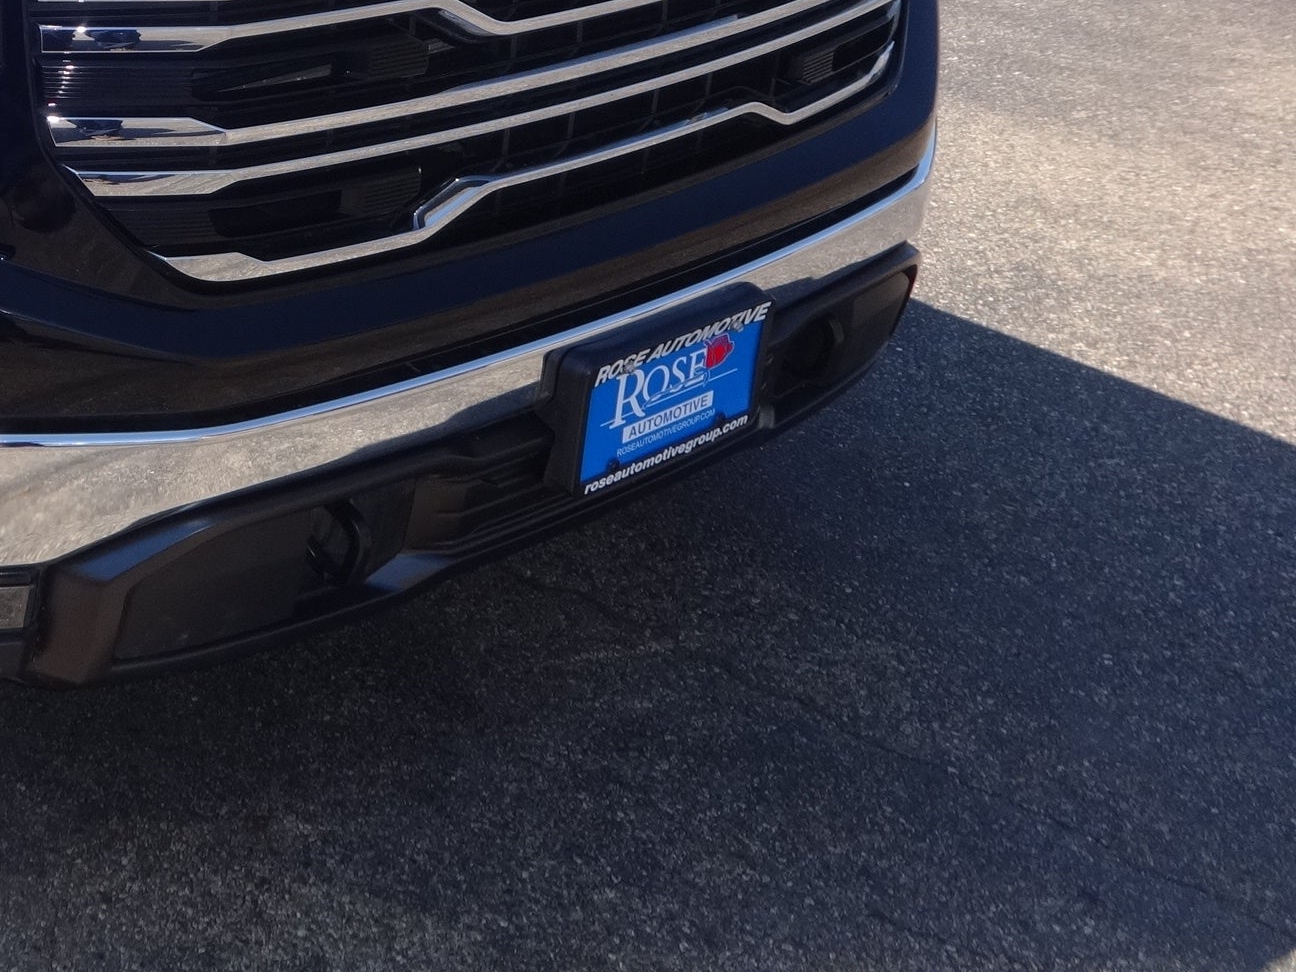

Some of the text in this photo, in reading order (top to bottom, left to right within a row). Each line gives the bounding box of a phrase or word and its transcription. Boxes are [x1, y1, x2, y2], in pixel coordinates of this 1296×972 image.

[594, 301, 772, 388] ROSE AUTOMOTIVE
[608, 346, 708, 429] ROSE
[627, 394, 709, 439] AUTOMOTIVE
[584, 414, 749, 495] roseautomotivegroup.com
